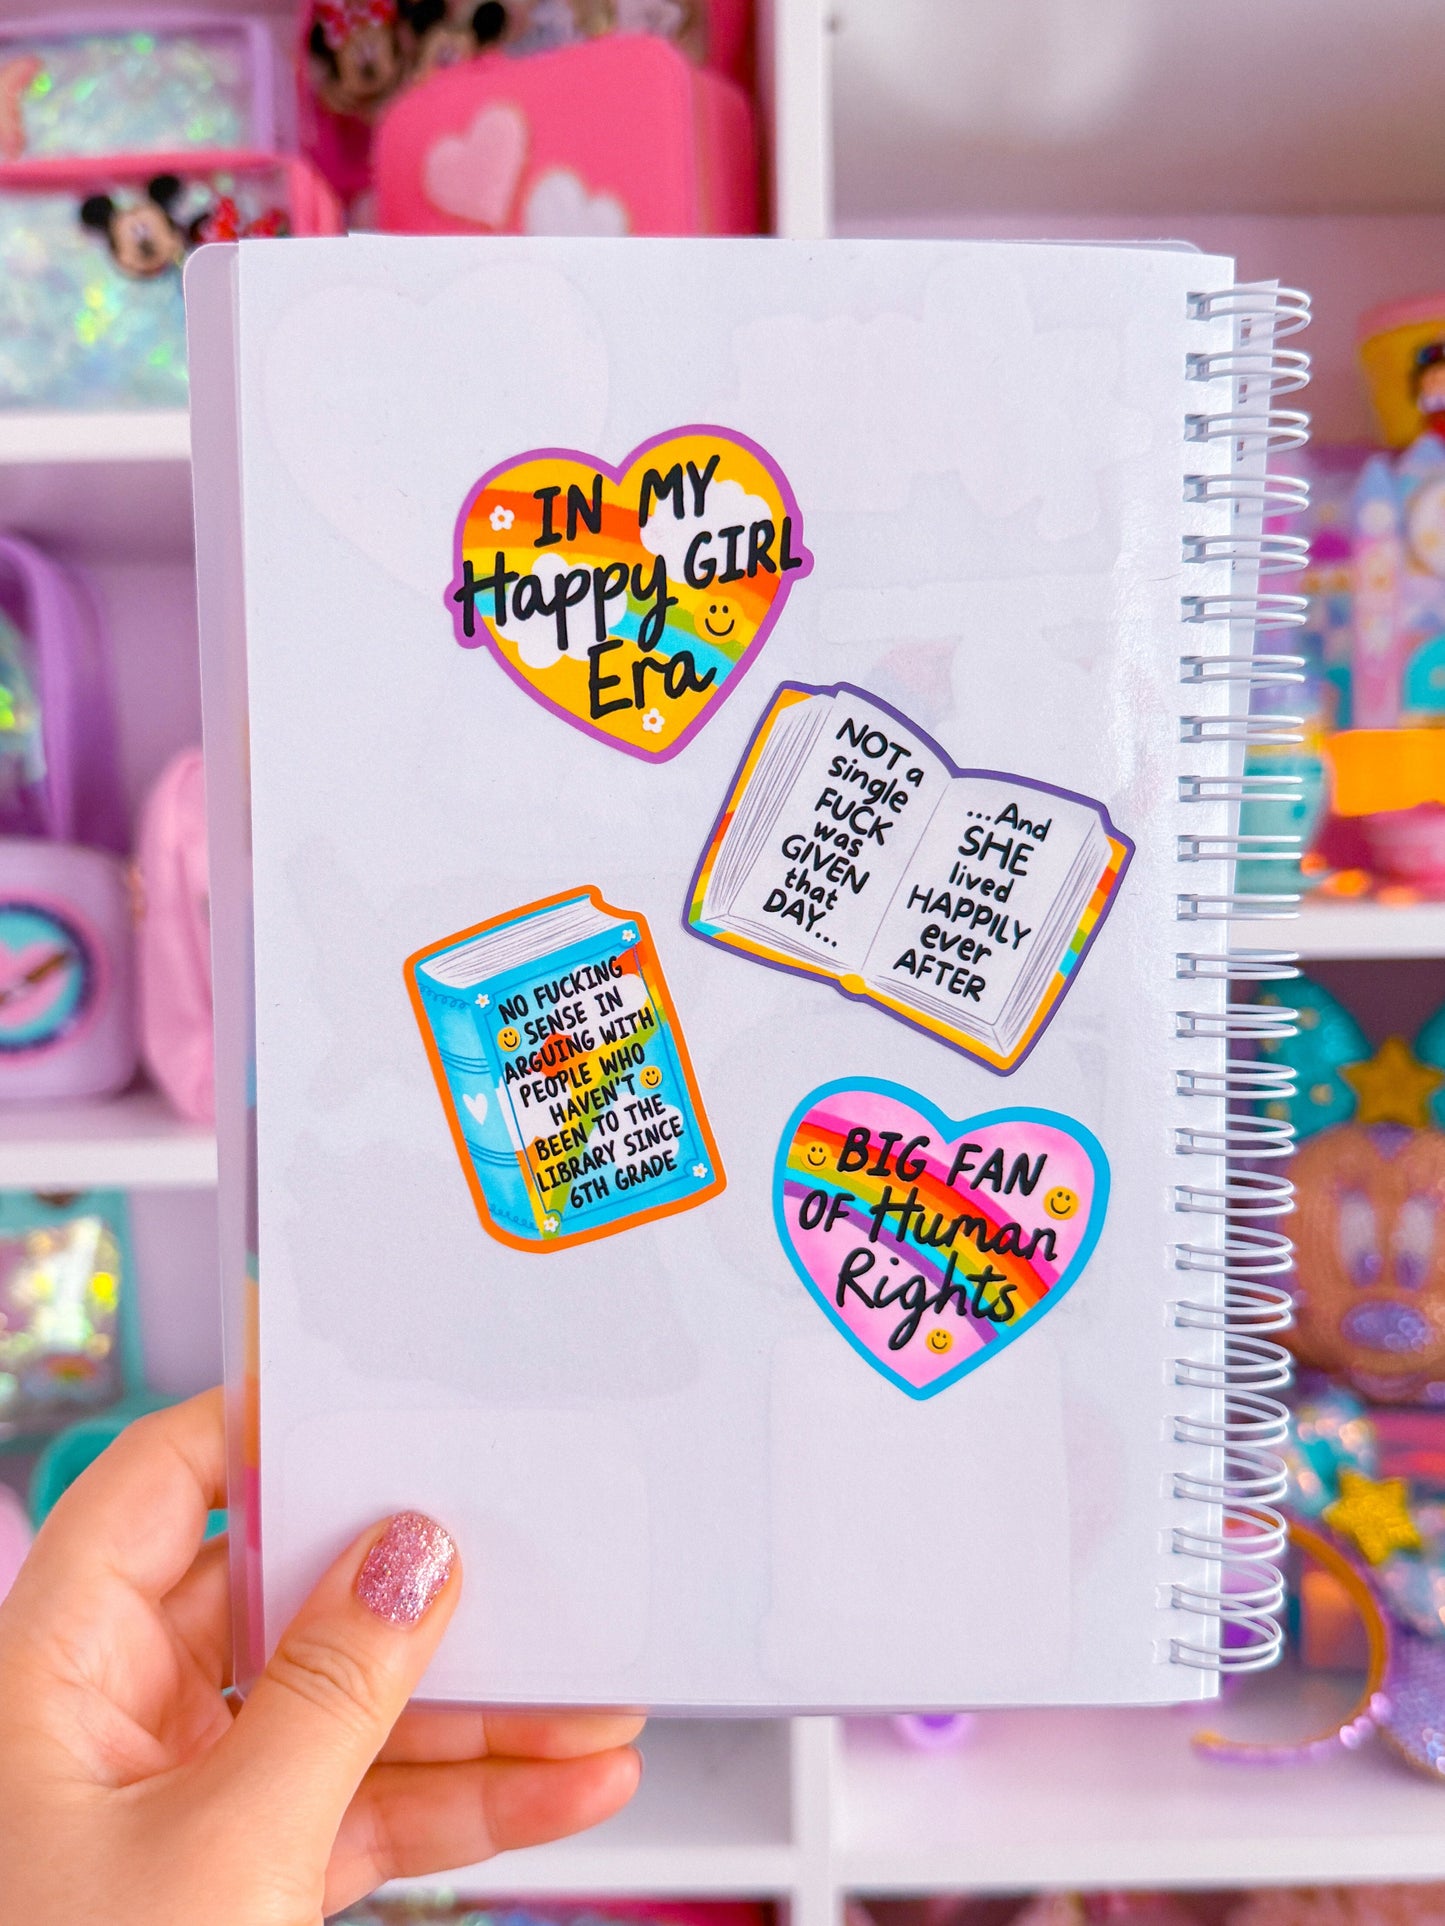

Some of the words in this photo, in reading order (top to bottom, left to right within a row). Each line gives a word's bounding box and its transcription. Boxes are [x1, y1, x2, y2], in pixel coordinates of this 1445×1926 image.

[533, 474, 602, 548] IN
[639, 455, 721, 528] MY
[454, 551, 678, 652] Happy
[684, 516, 802, 589] GIRL
[588, 639, 717, 719] Era
[836, 718, 911, 770] NOT
[906, 767, 924, 787] a
[829, 755, 909, 813] single
[814, 821, 863, 857] was
[815, 787, 893, 845] FUCK
[966, 803, 1052, 842] ...And
[781, 834, 870, 894] GIVEN
[957, 825, 1034, 877] SHE
[784, 867, 838, 910] that
[948, 861, 1014, 903] lived
[762, 889, 837, 947] DAY...
[906, 884, 1031, 950] HAPPILY
[920, 924, 992, 965] ever
[498, 998, 528, 1025] NO
[533, 955, 623, 1010] FUCKING
[893, 948, 985, 1003] AFTER
[524, 1001, 587, 1045] SENSE
[595, 986, 623, 1017] IN
[504, 1028, 595, 1085] ARGUING
[599, 1007, 655, 1044] WITH
[519, 1062, 592, 1108] PEOPLE
[599, 1043, 645, 1074] WHO
[535, 1122, 588, 1161] BEEN
[592, 1110, 619, 1137] TO
[624, 1093, 666, 1124] THE
[549, 1073, 635, 1126] HAVEN'T
[536, 1141, 615, 1192] LIBRARY
[624, 1115, 684, 1155] SINCE
[570, 1173, 609, 1208] 6TH
[614, 1150, 677, 1189] GRADE
[836, 1127, 930, 1181] BIG
[946, 1143, 1048, 1196] FAN
[799, 1189, 855, 1232] OF
[869, 1186, 1057, 1261] Human
[836, 1247, 1018, 1350] Rights
